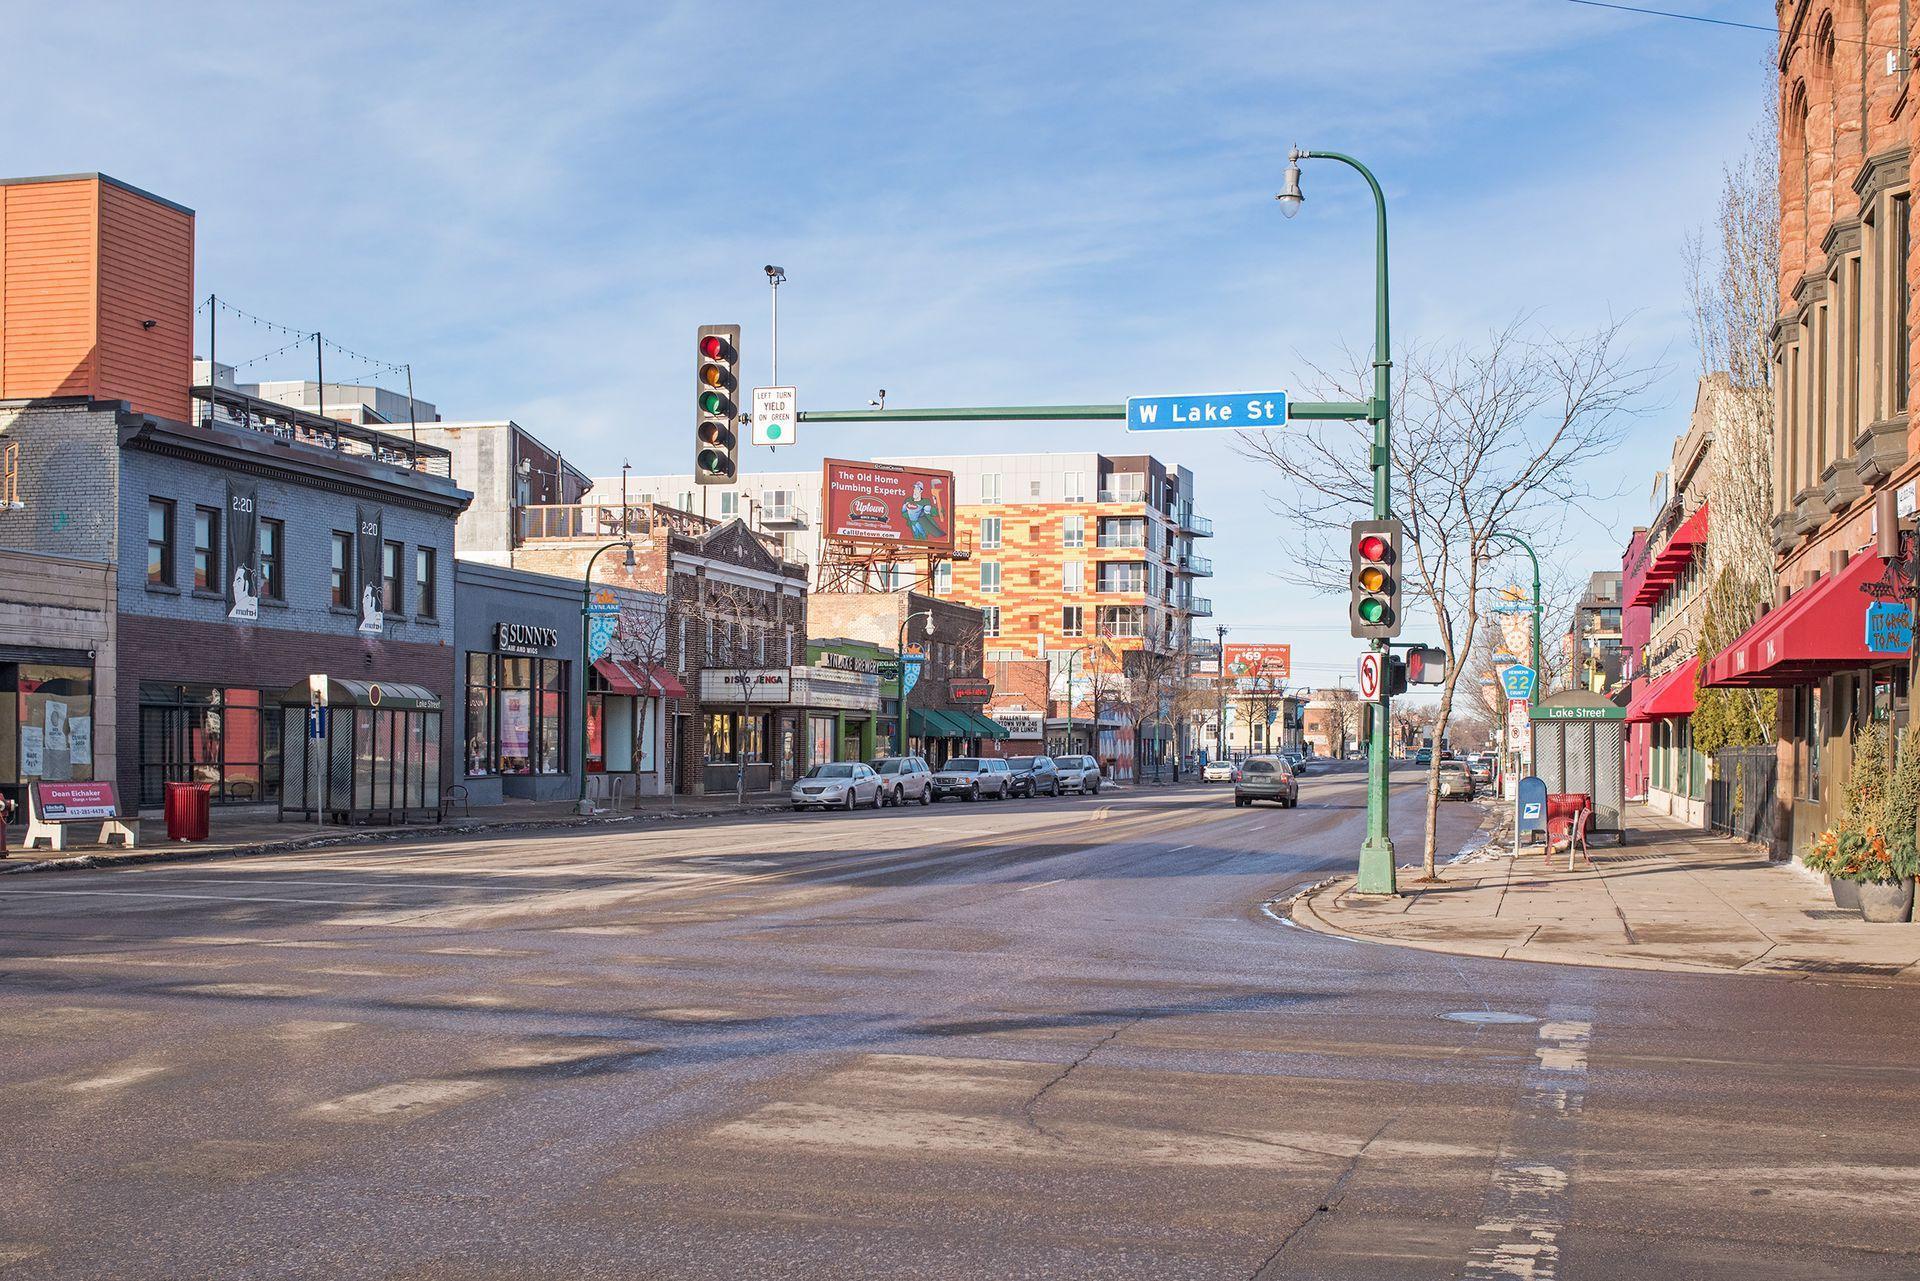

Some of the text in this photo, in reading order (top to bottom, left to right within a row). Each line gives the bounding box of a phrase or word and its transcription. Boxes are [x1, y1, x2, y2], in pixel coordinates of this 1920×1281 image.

[757, 391, 792, 400] LEFT TURN
[764, 402, 785, 411] YIELD
[771, 413, 790, 421] GREEN
[1139, 400, 1275, 424] W Lake St
[838, 471, 899, 485] The Old Home
[831, 481, 906, 497] Plumbing Experts
[232, 496, 253, 513] 2:20
[854, 500, 885, 515] Uptown
[361, 521, 378, 537] 2:20
[510, 623, 558, 647] SUNNY'S
[516, 645, 526, 653] AND
[1242, 651, 1261, 661] $69
[754, 675, 783, 685] JENGA
[1508, 676, 1529, 690] 22
[416, 700, 441, 709] Lake Street
[1549, 708, 1606, 718] Lake Street
[51, 789, 101, 798] Dean Eichaker
